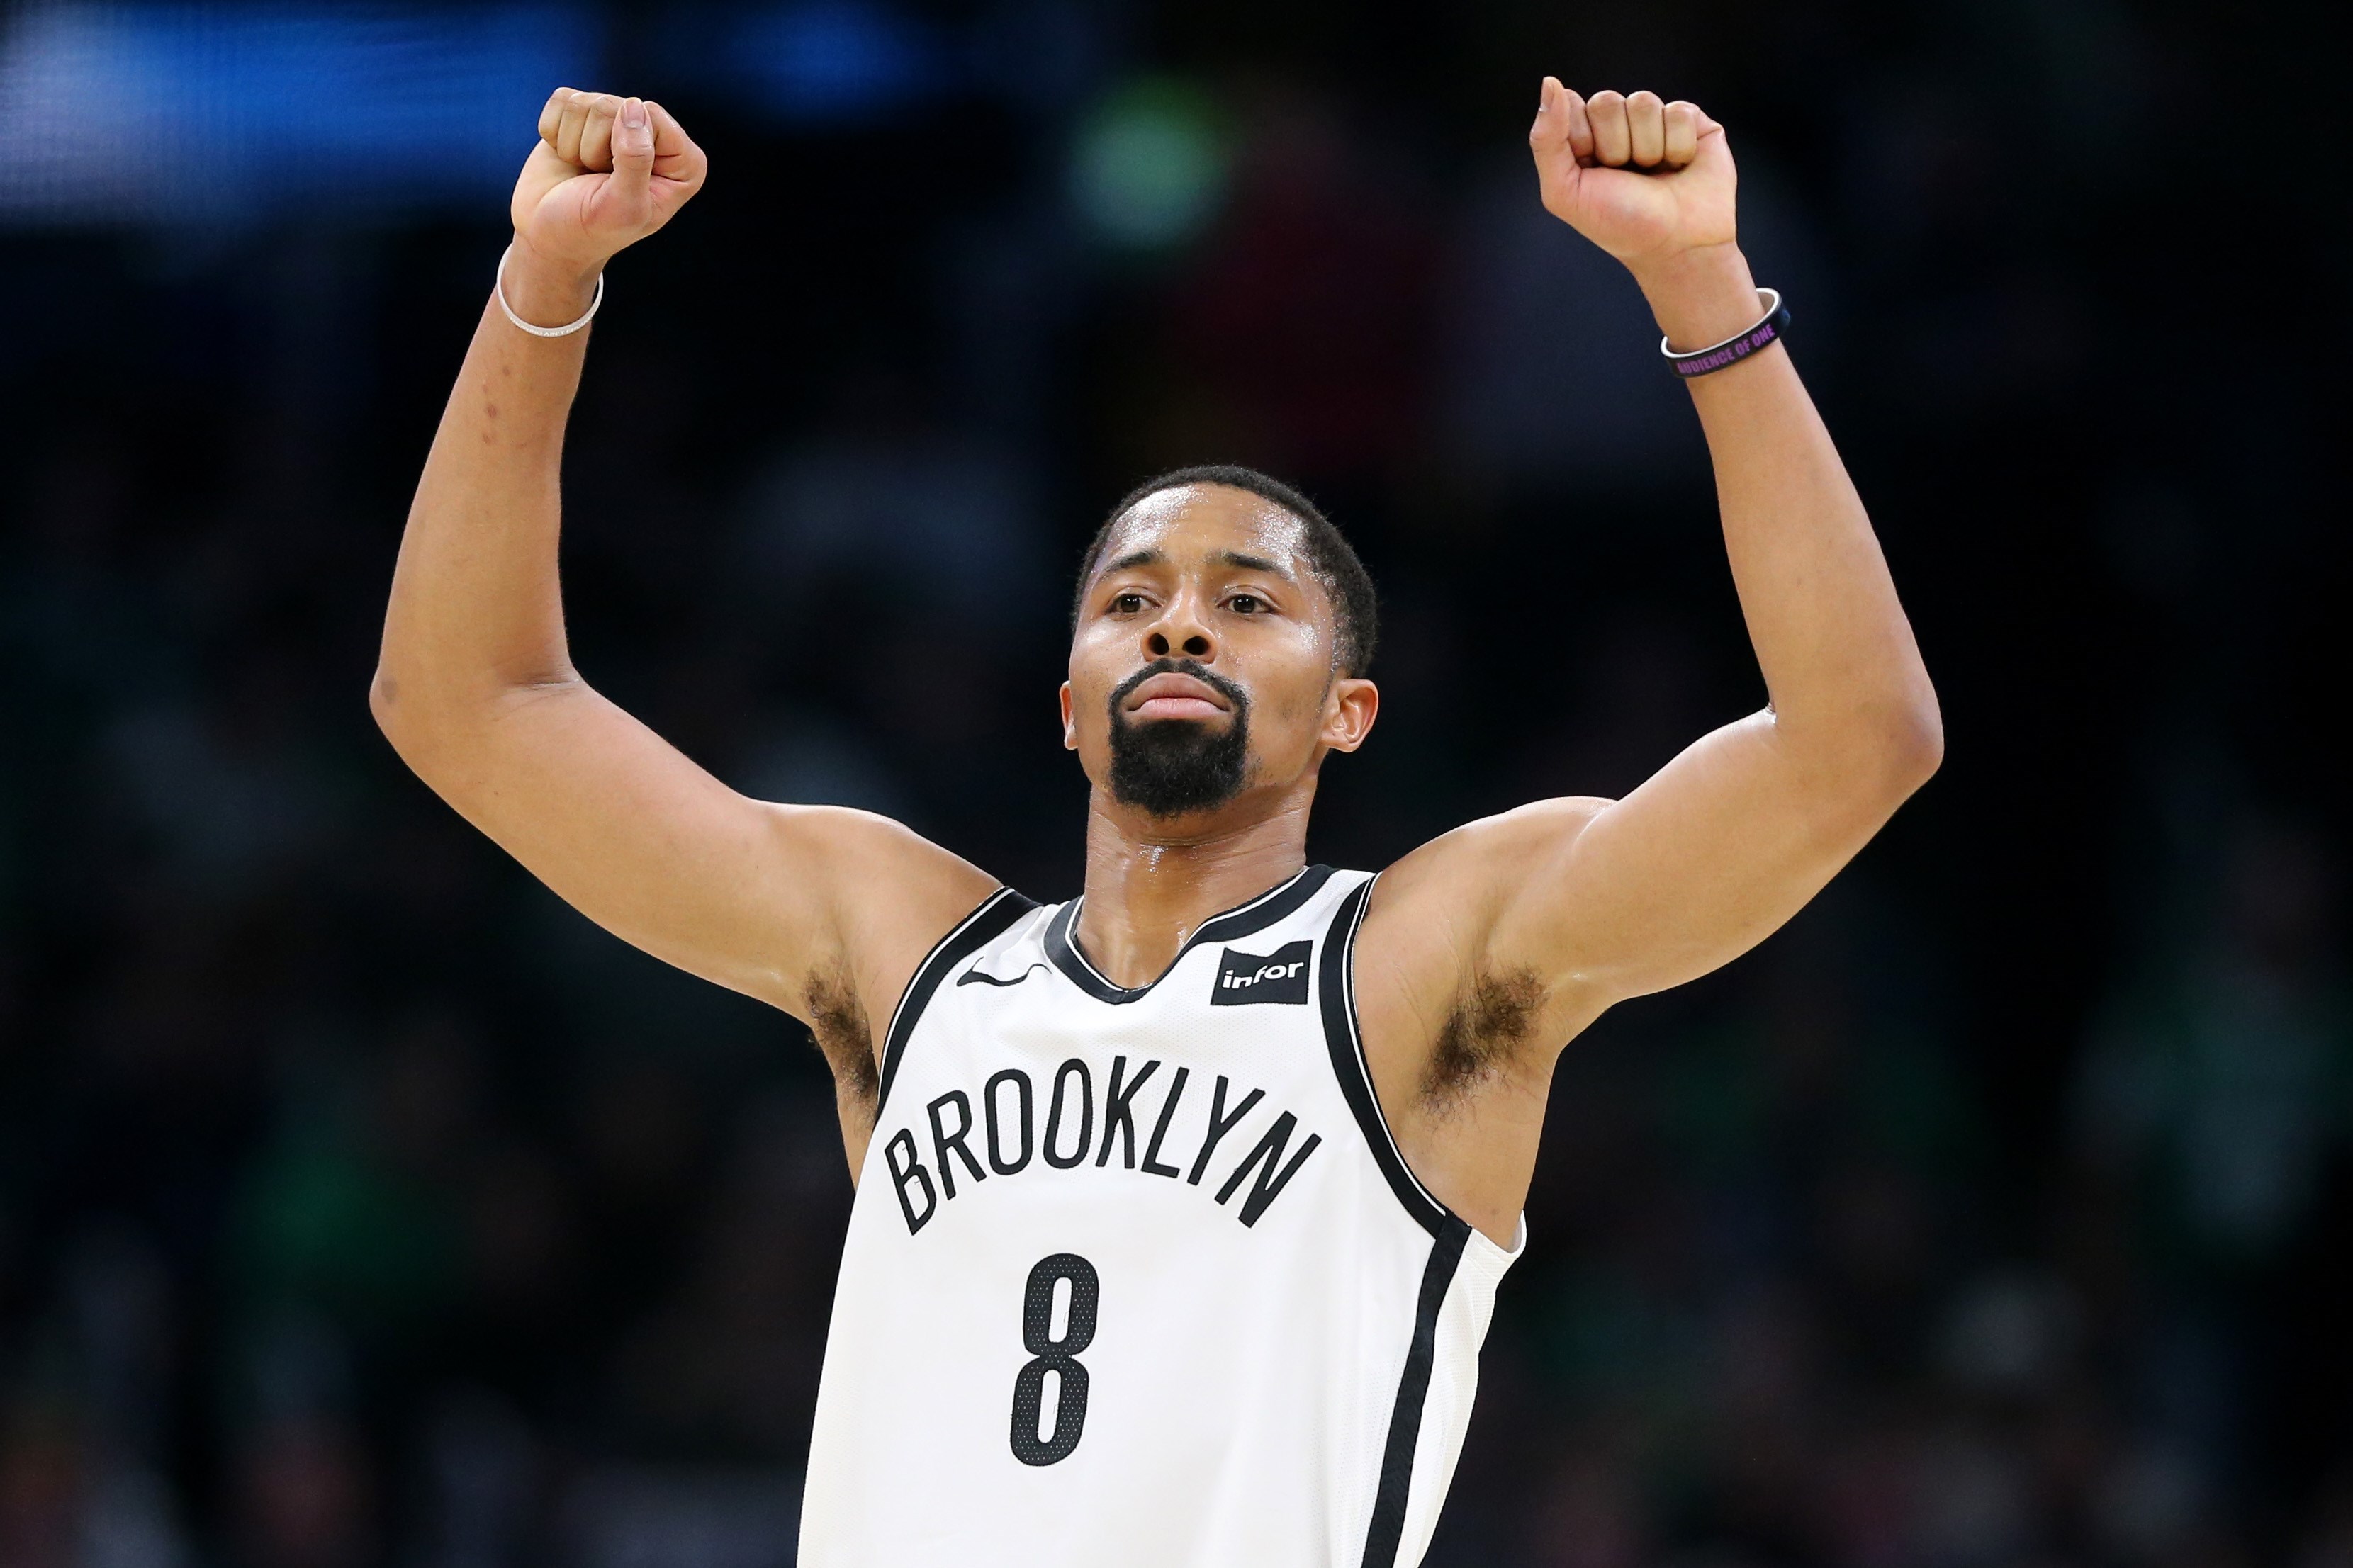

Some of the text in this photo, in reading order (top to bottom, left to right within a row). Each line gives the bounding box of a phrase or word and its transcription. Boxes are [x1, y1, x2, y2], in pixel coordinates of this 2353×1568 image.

[1676, 323, 1775, 375] AUDIENCE OF ONE
[1222, 961, 1304, 989] infor
[885, 1056, 1322, 1236] BROOKLYN
[1010, 1253, 1099, 1467] 8
